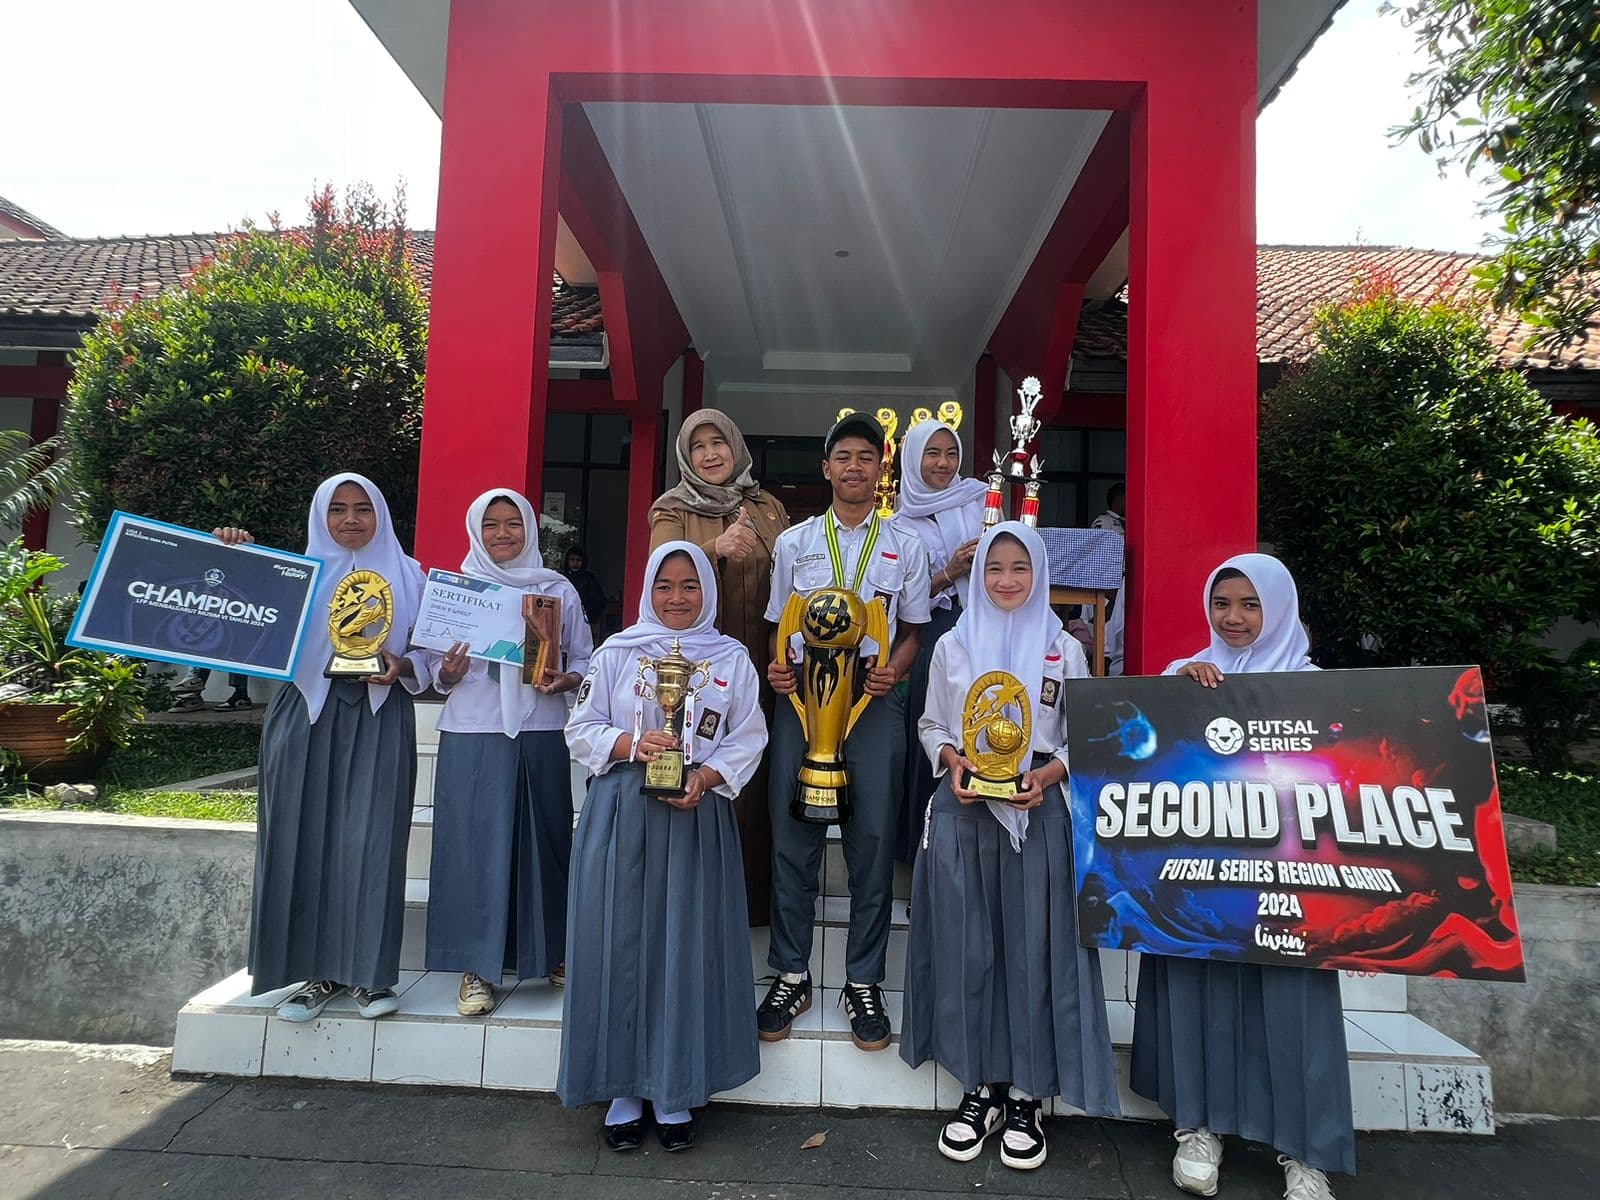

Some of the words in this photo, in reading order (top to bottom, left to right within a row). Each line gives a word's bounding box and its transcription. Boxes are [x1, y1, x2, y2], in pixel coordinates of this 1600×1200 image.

[127, 581, 280, 624] CHAMPIONS
[432, 588, 504, 611] SERTIFIKAT
[1247, 720, 1319, 735] FUTSAL
[1249, 737, 1313, 752] SERIES
[1095, 780, 1280, 840] SECOND
[1294, 781, 1474, 852] PLACE
[1158, 858, 1216, 881] FUTSAL
[1218, 859, 1275, 883] SERIES
[1278, 860, 1342, 888] REGION
[1339, 865, 1403, 894] GARUT
[1257, 892, 1303, 918] 2024
